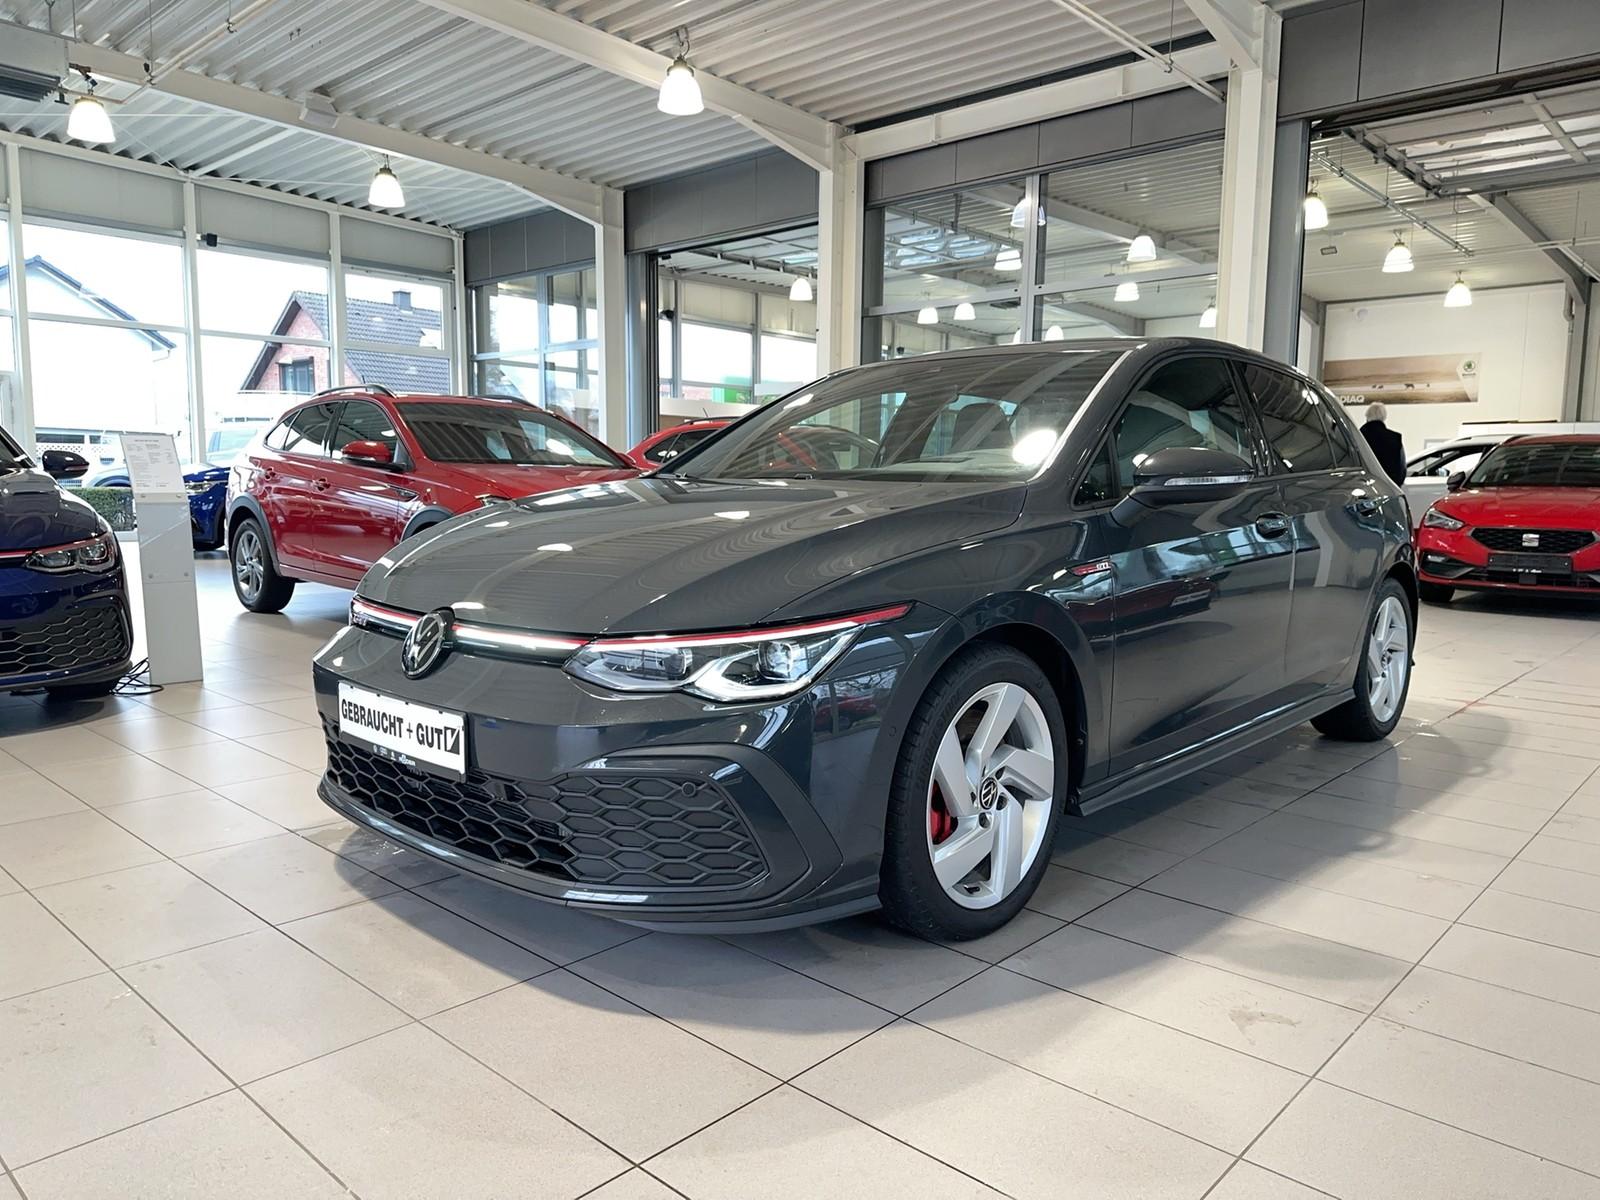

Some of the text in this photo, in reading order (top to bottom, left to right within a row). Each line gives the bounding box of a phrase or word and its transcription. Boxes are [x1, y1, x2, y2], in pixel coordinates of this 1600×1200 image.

[341, 698, 443, 751] GEBRAUCHT + GUT
